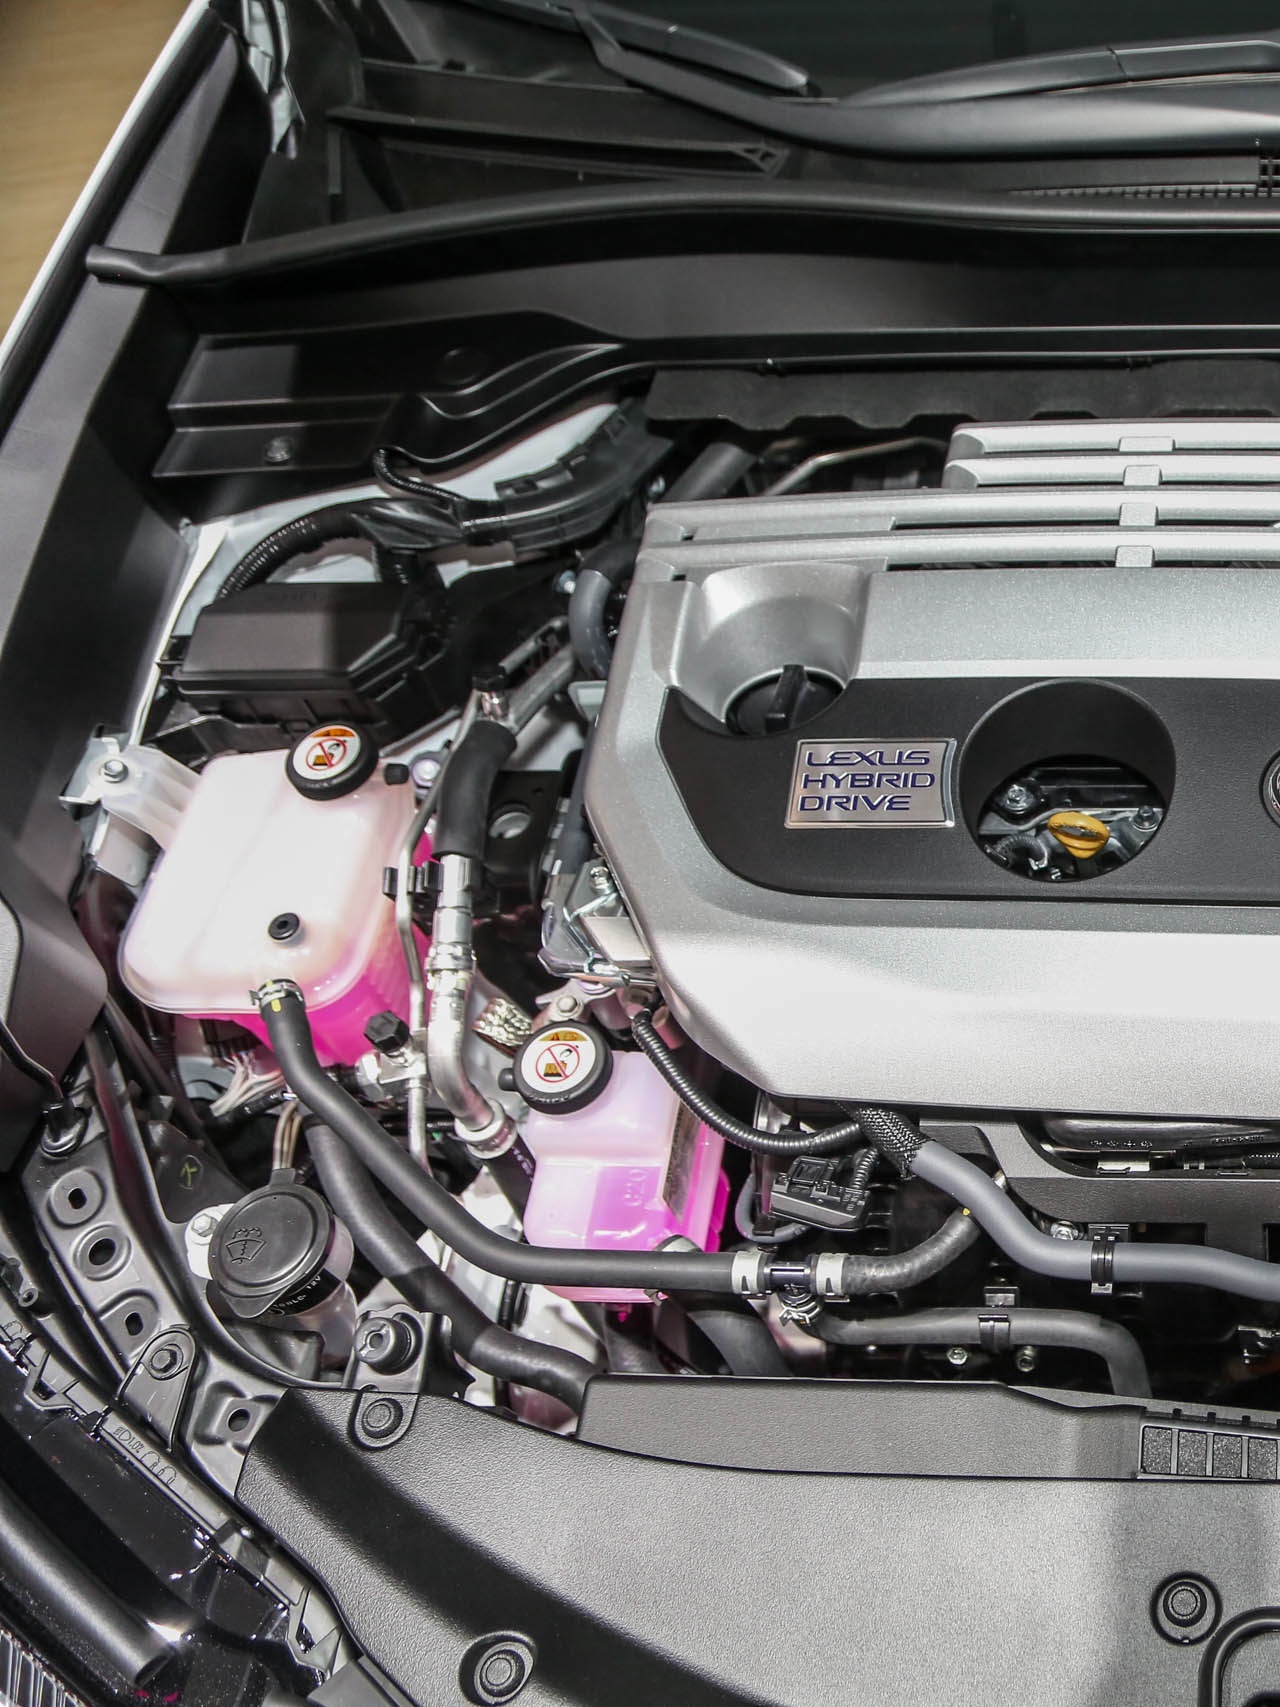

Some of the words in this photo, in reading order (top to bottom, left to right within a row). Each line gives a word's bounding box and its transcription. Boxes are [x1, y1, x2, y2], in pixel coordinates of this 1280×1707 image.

[806, 750, 930, 767] LEXUS
[802, 772, 936, 789] HYBRID
[798, 795, 911, 812] DRIVE
